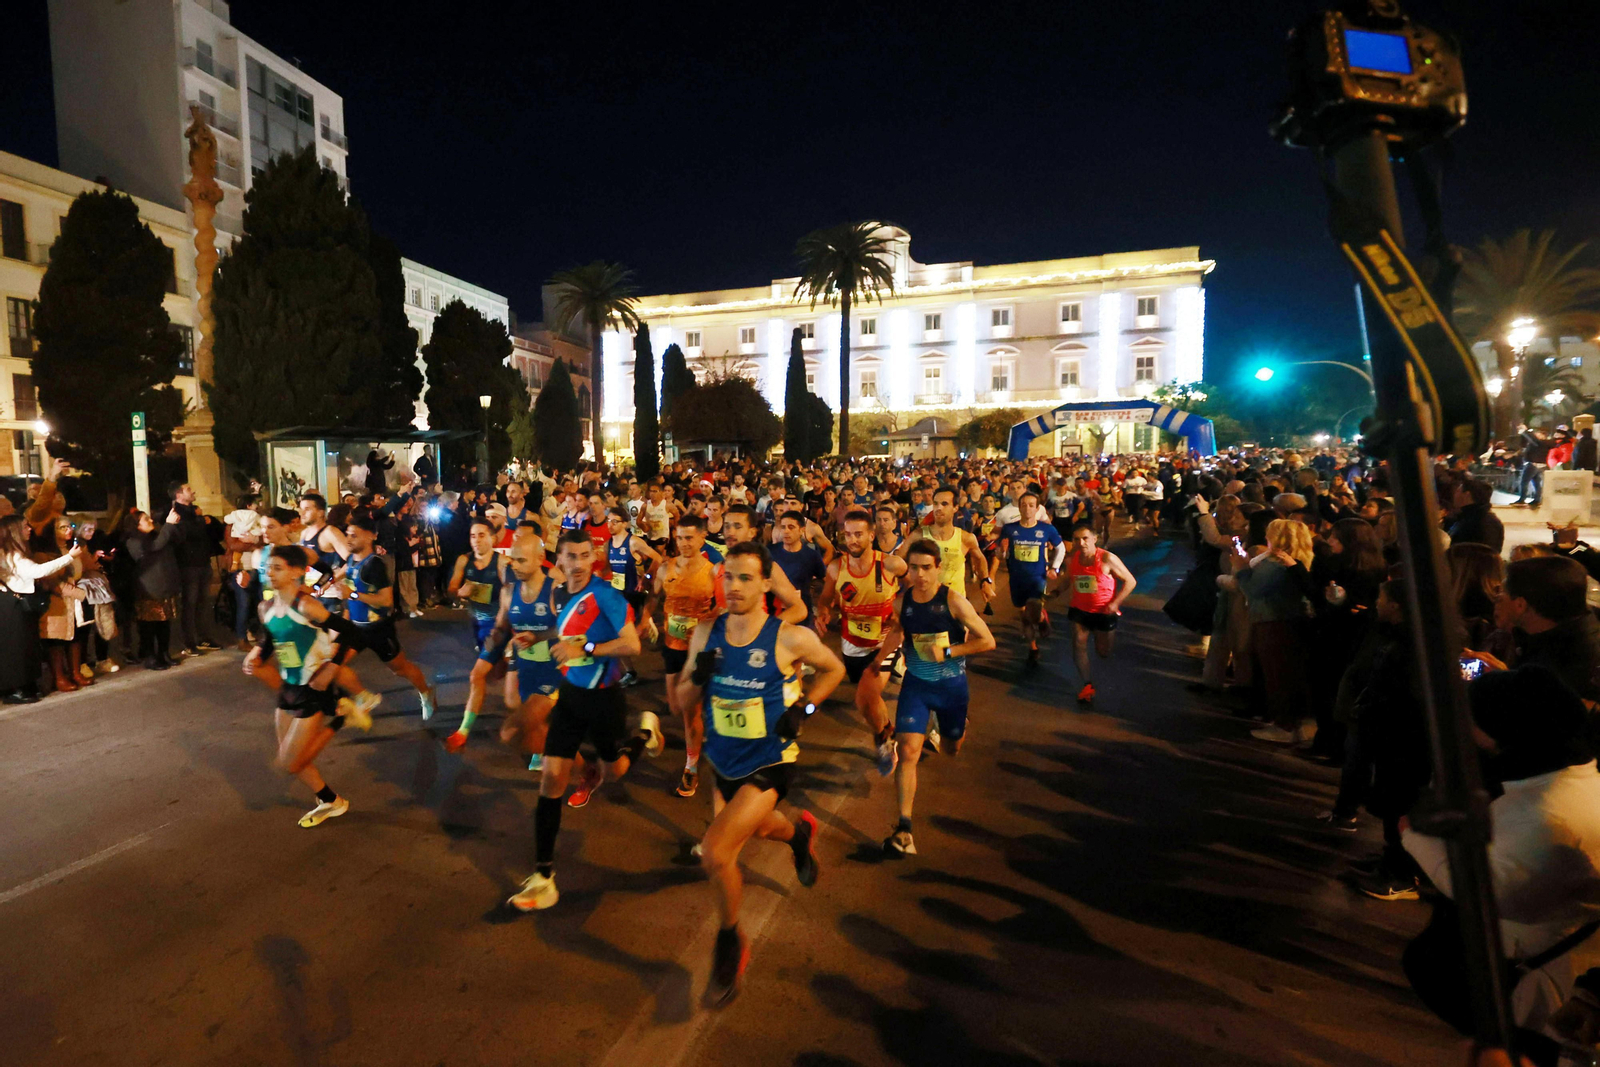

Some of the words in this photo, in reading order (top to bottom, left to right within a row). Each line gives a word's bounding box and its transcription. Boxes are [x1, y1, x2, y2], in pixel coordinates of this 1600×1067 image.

[1021, 550, 1032, 558] 47
[856, 623, 871, 633] 45
[724, 713, 747, 728] 10
